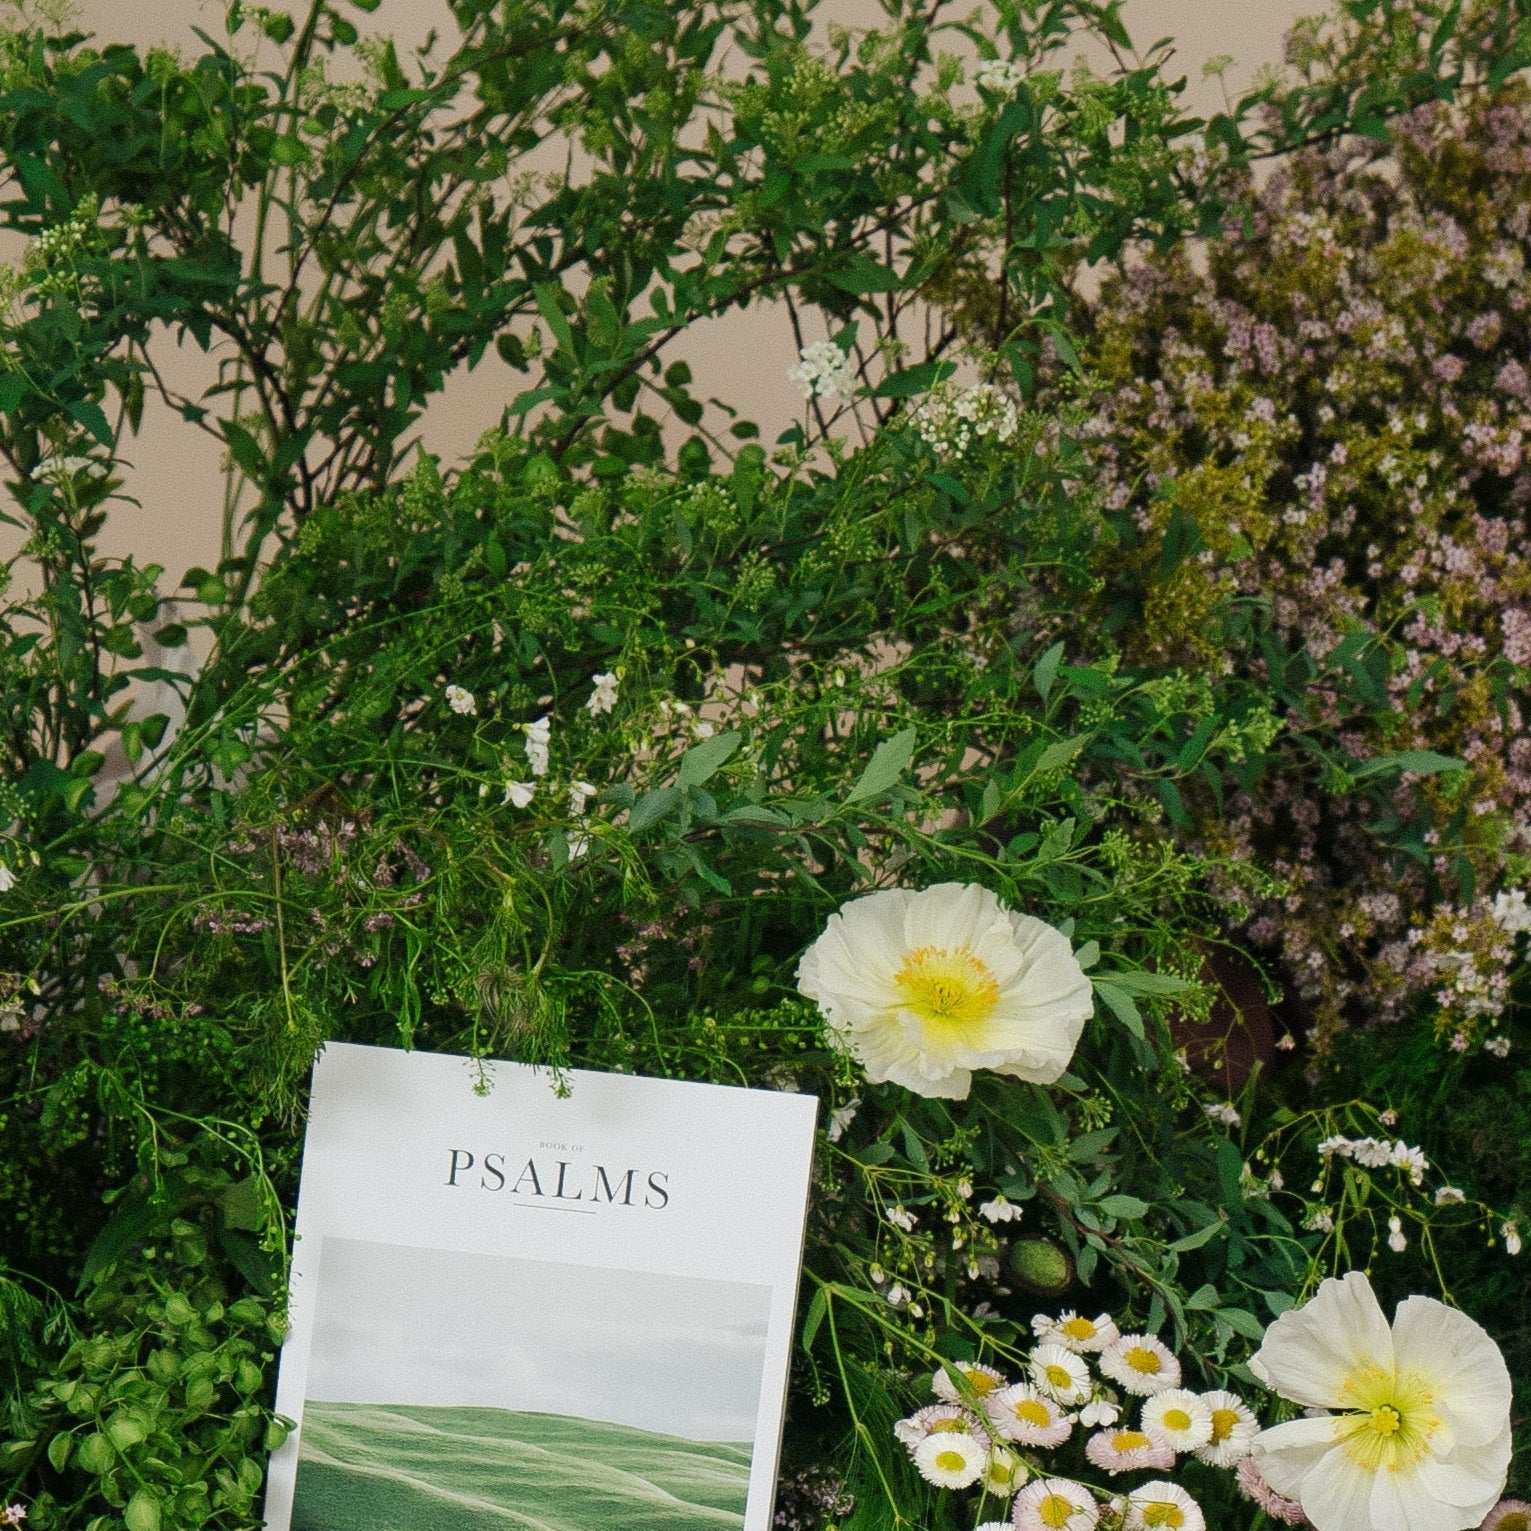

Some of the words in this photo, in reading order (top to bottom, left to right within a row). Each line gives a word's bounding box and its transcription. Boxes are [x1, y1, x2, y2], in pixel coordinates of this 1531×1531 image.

[539, 1141, 568, 1151] BOOK
[571, 1145, 584, 1153] OF
[444, 1148, 670, 1210] PSALMS
